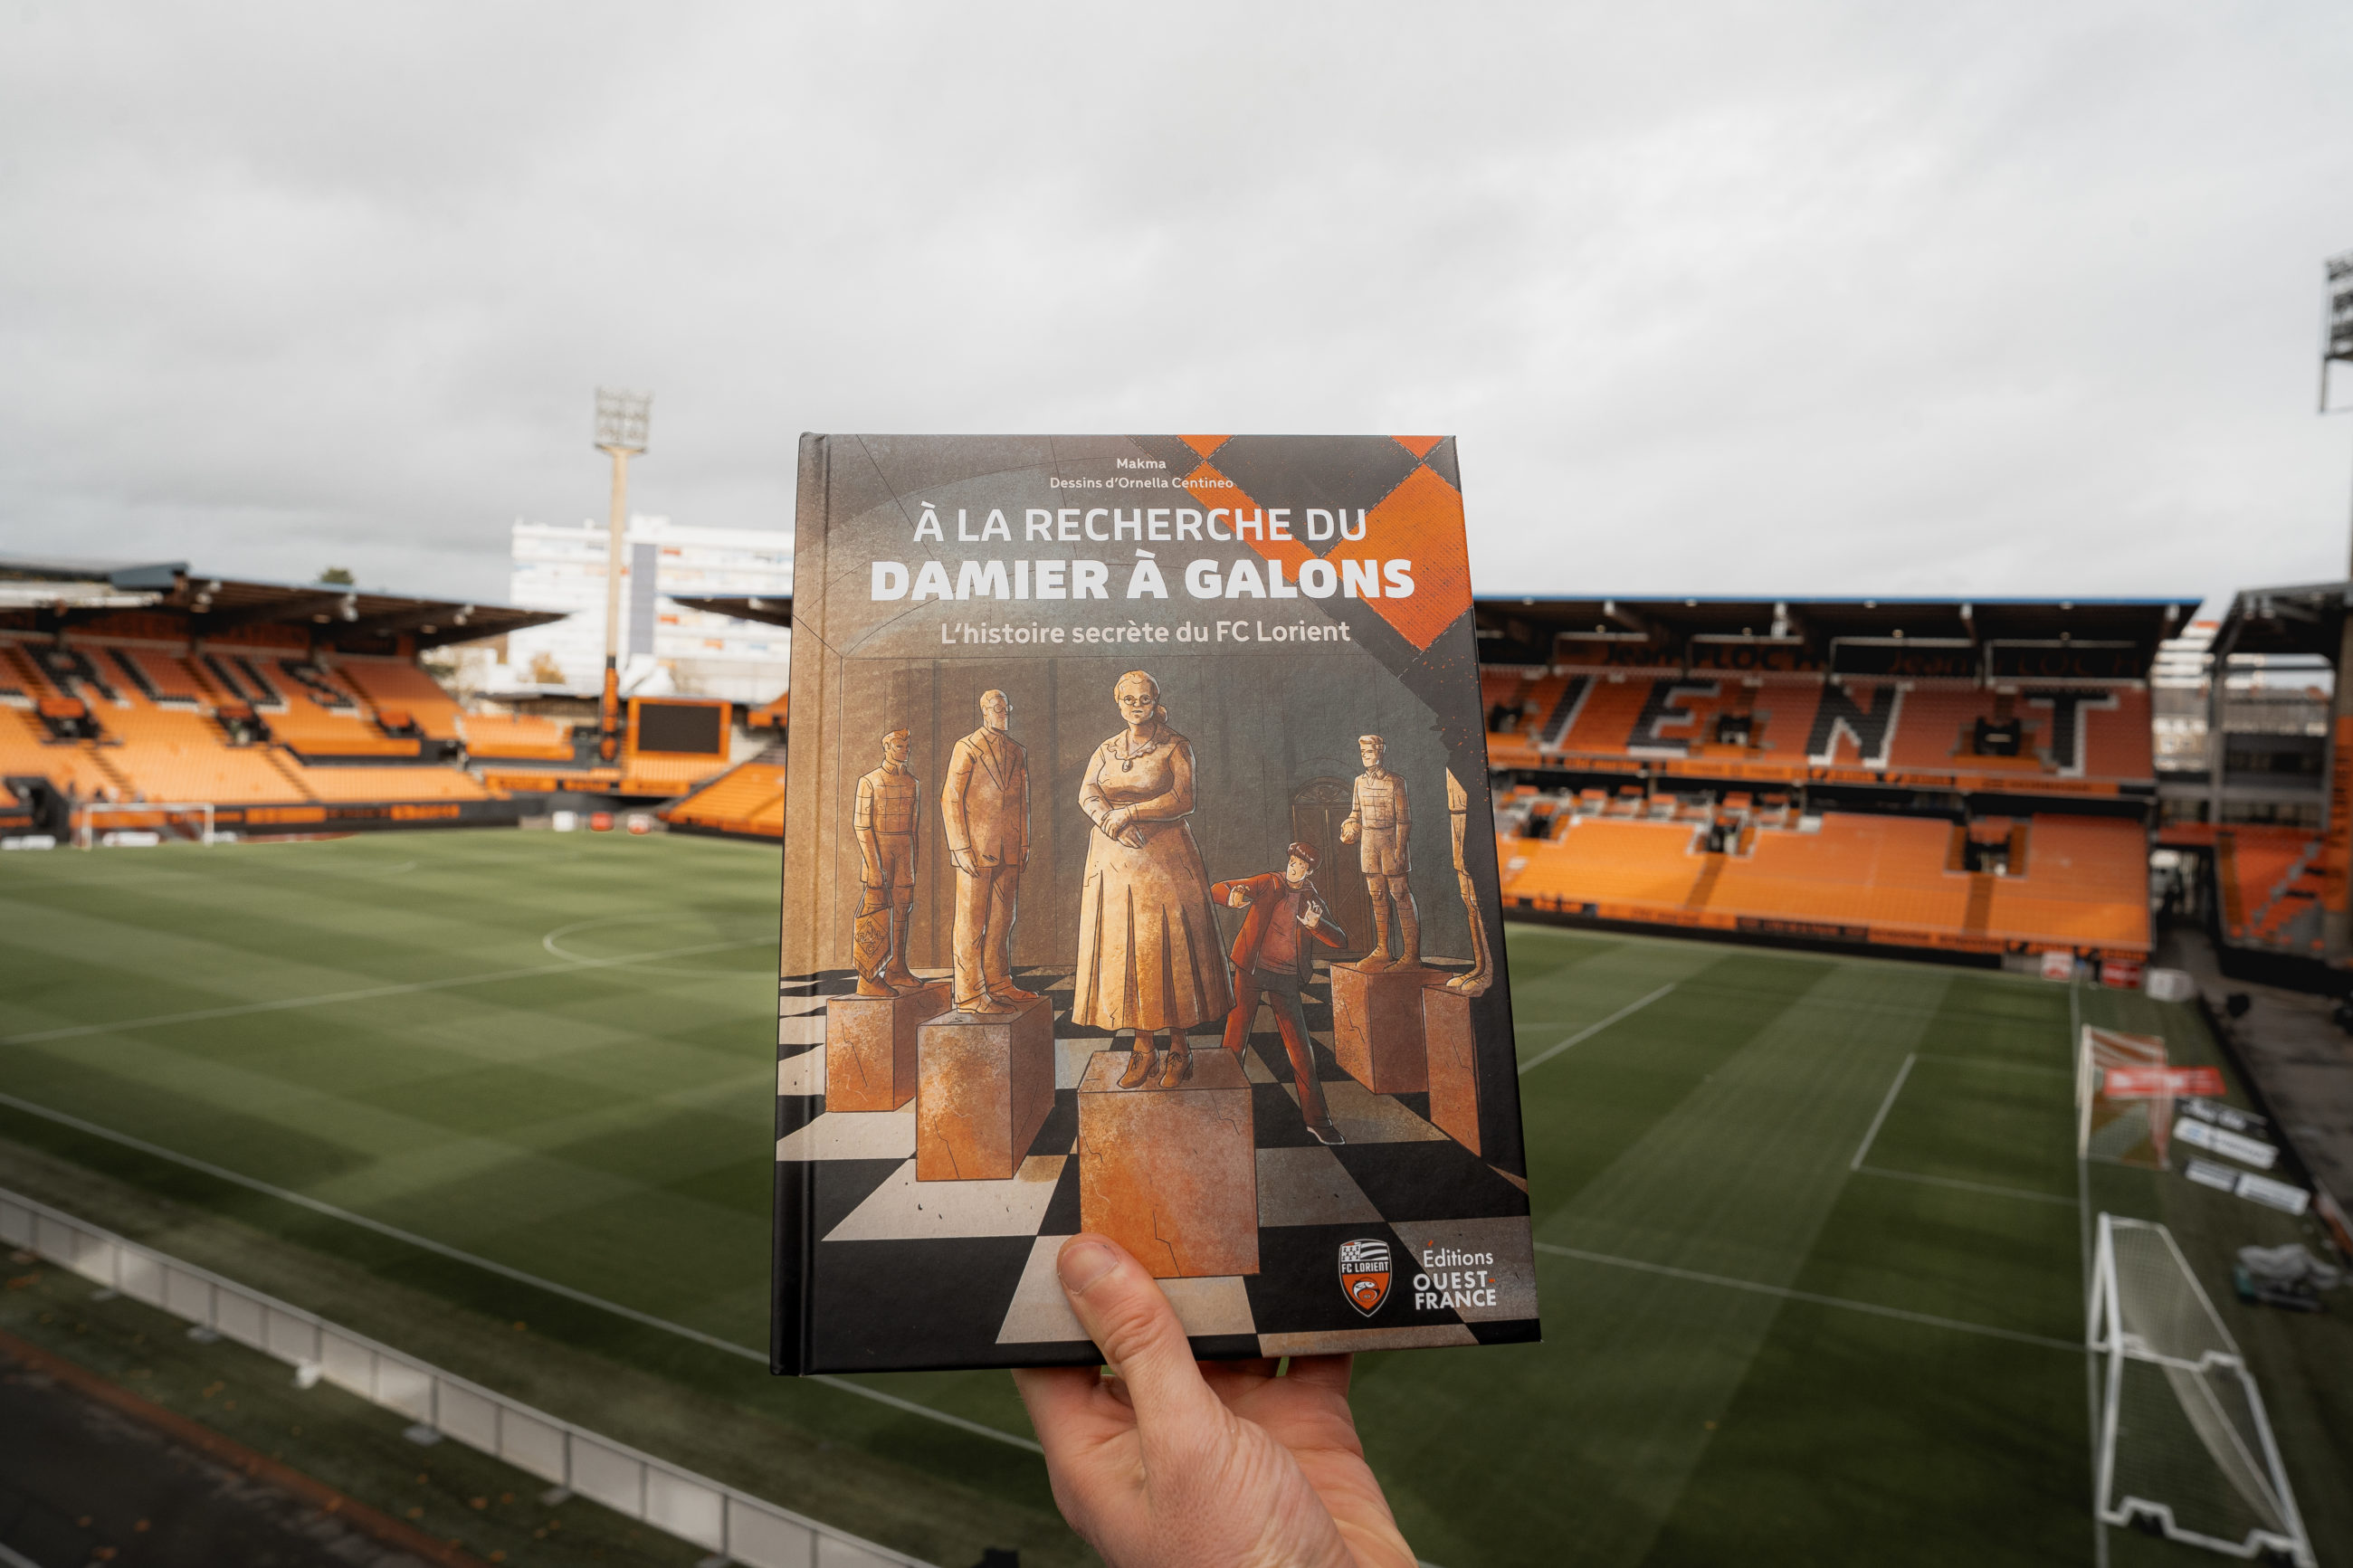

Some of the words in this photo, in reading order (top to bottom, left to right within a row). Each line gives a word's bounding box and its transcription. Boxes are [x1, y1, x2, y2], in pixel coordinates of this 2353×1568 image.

[1117, 458, 1167, 470] Makma
[1050, 477, 1102, 489] Dessins
[1105, 477, 1169, 489] d’Ornella
[1171, 477, 1234, 489] Centineo
[913, 500, 945, 542] À
[957, 508, 1012, 542] LA
[1025, 508, 1292, 542] RECHERCHE
[1306, 508, 1367, 542] DU
[871, 559, 1110, 602] DAMIER
[1126, 547, 1169, 599] À
[1184, 558, 1415, 601] GALONS
[941, 621, 1065, 644] L’histoire
[1072, 619, 1169, 643] secrète
[1176, 621, 1209, 642] du
[1216, 620, 1250, 642] FC
[1256, 620, 1351, 642] Lorient
[0, 641, 364, 719] RLUS
[1538, 676, 2119, 776] IENT
[1341, 1262, 1352, 1273] FC
[1355, 1260, 1389, 1273] LORIENT
[1423, 1240, 1494, 1269] Éditions
[1415, 1288, 1497, 1310] FRANCE
